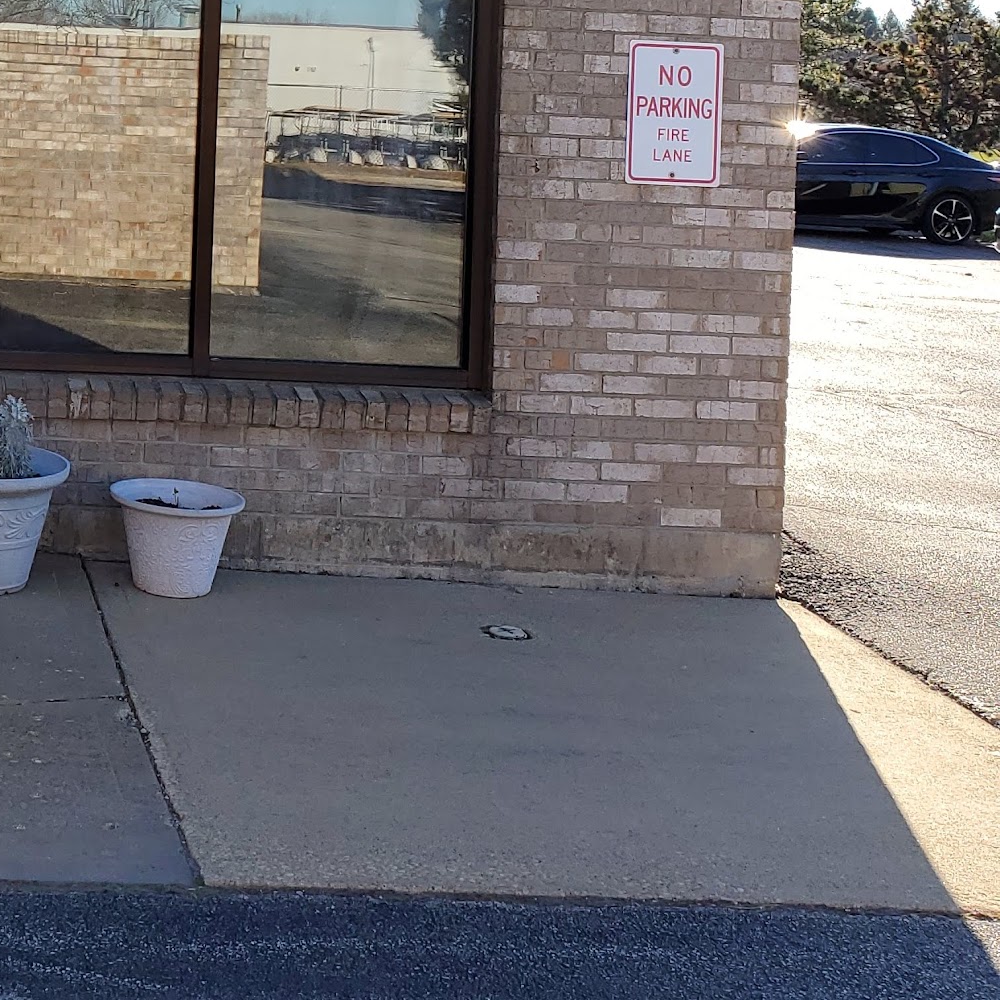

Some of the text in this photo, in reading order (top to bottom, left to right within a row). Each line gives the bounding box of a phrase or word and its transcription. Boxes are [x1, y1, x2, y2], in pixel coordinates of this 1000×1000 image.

[659, 65, 692, 87] NO
[636, 95, 713, 119] PARKING
[657, 128, 690, 142] FIRE
[652, 148, 692, 163] LANE
